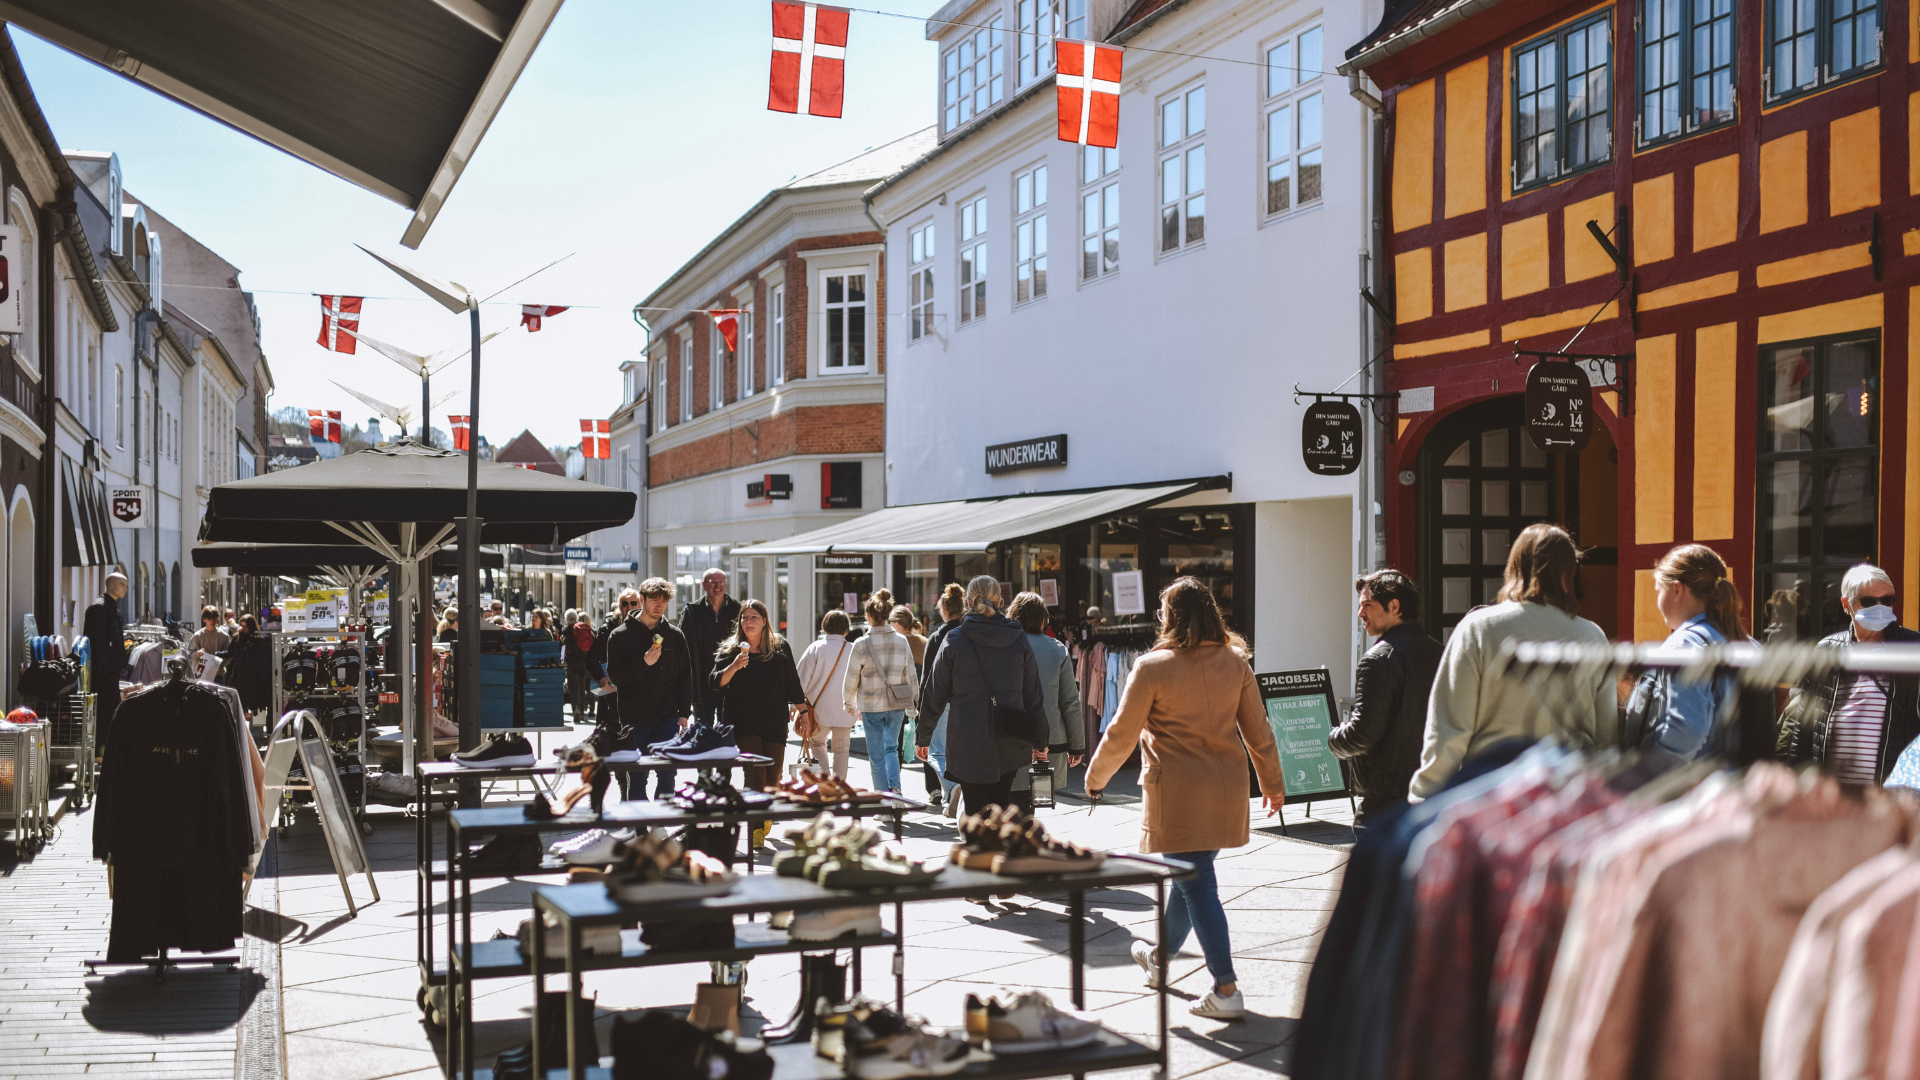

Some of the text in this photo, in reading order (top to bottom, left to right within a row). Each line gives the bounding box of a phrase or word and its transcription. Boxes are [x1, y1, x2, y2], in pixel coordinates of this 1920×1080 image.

[1570, 413, 1584, 428] 14
[1342, 443, 1354, 454] 14
[987, 441, 1058, 468] WUNDERWEAR
[116, 502, 140, 515] 24
[567, 550, 588, 558] matas
[312, 610, 334, 620] 50%
[1262, 673, 1326, 686] JACOBSEN
[1298, 700, 1320, 708] ÅBENT
[1286, 717, 1315, 725] UDENFOR
[1290, 739, 1321, 748] INDENFOR
[1320, 773, 1330, 784] 14
